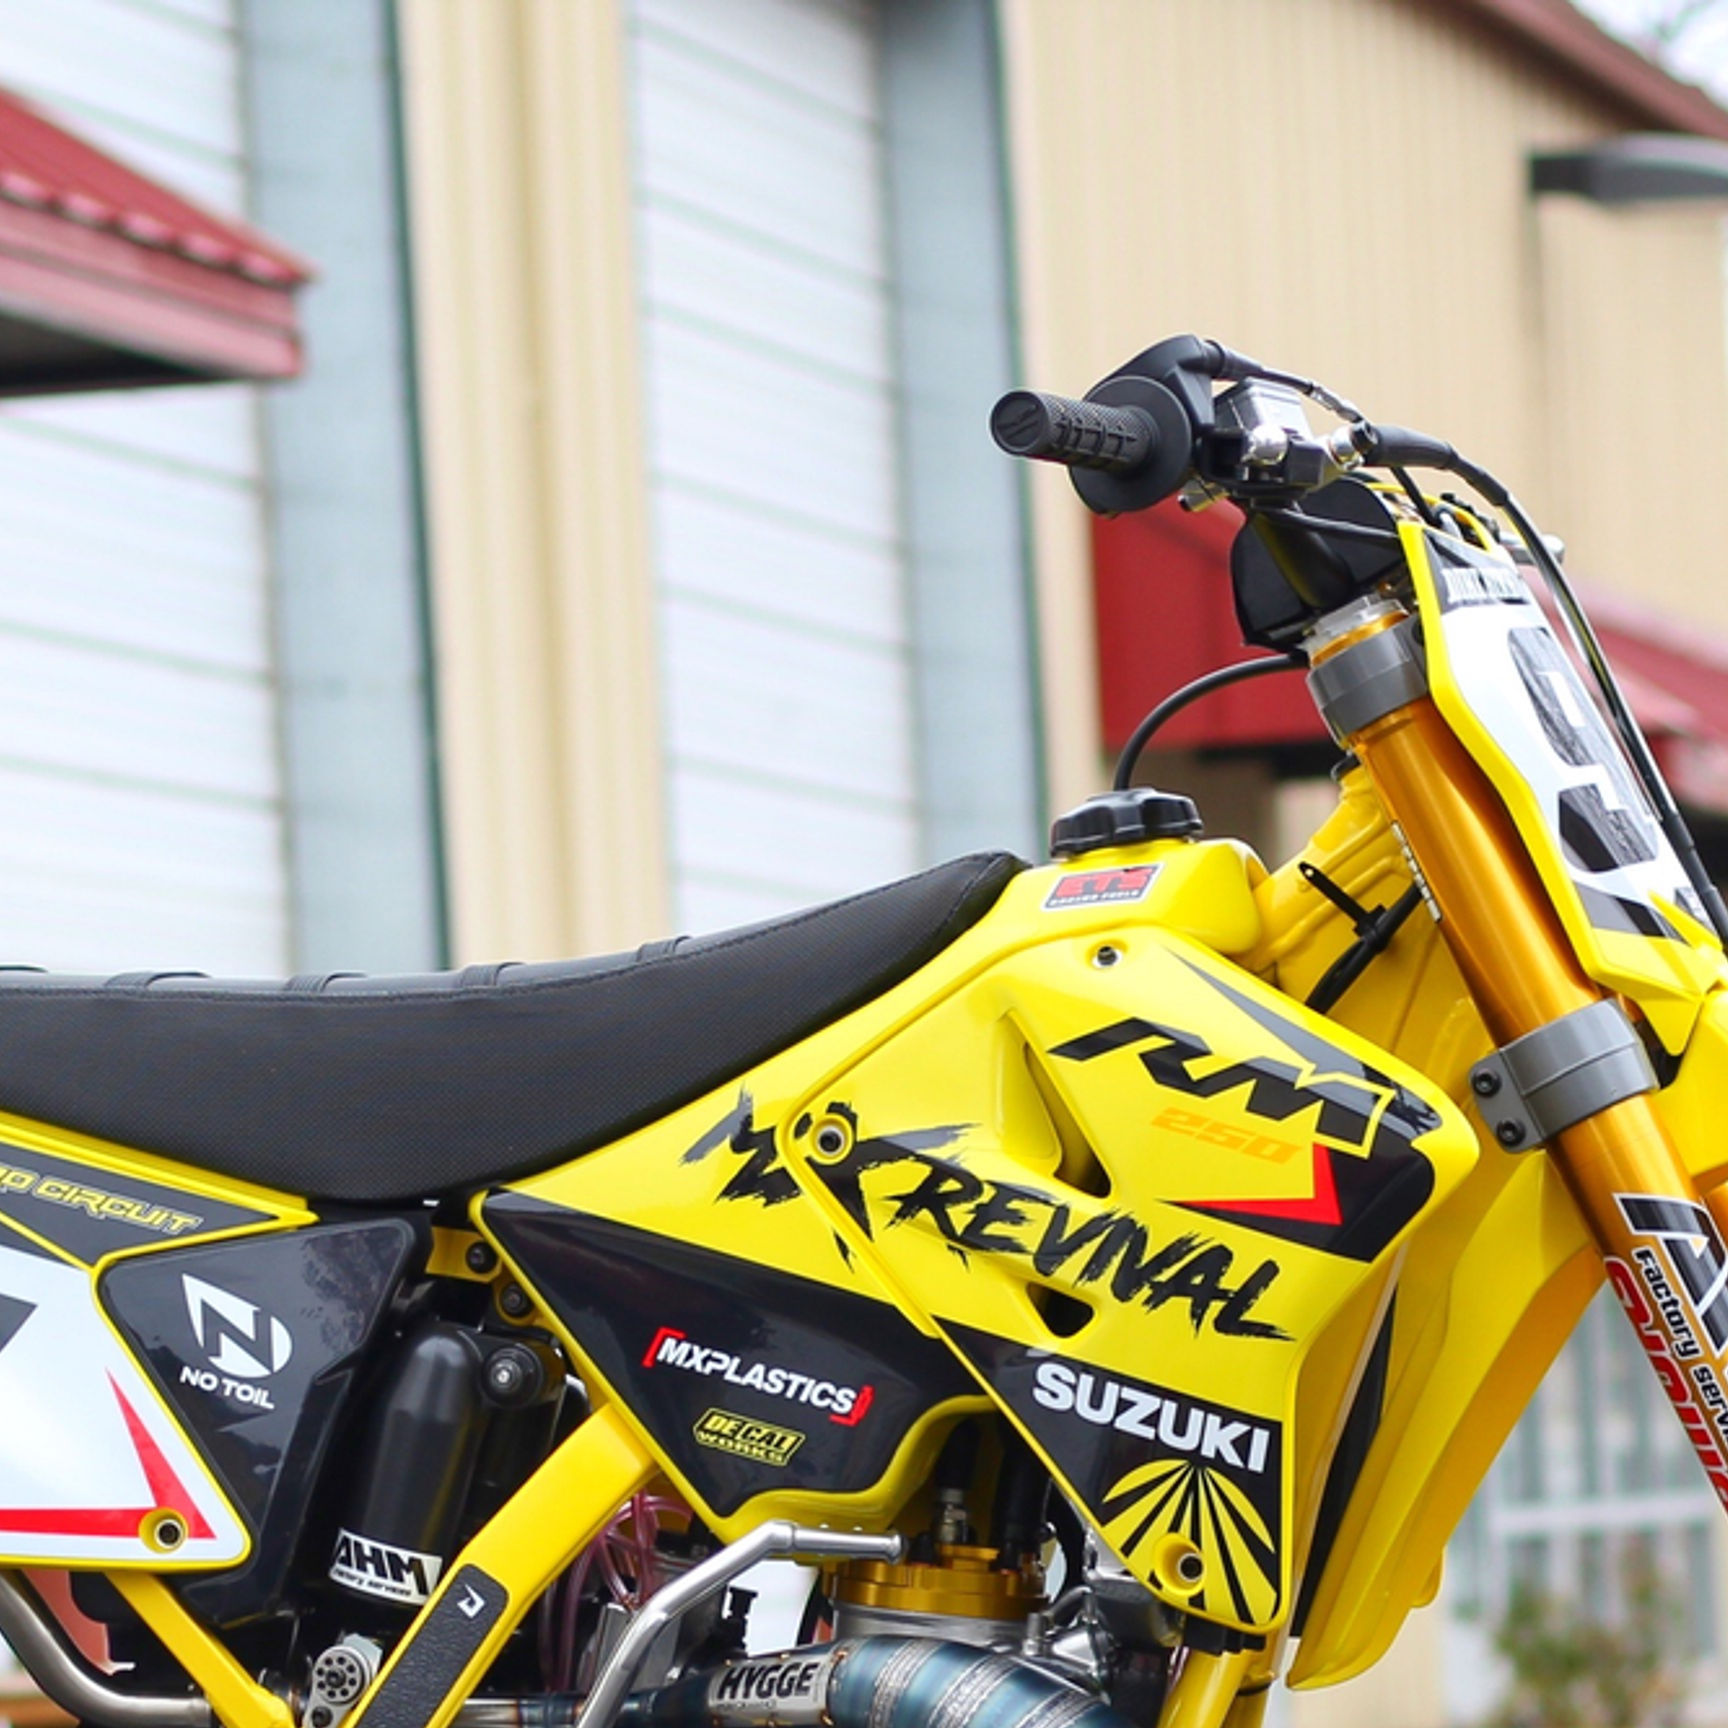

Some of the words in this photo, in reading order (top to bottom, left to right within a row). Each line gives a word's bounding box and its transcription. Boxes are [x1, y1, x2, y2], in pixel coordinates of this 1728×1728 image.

[1151, 1106, 1302, 1164] 250
[31, 1176, 204, 1235] CIRCUIT
[884, 1158, 1295, 1341] REVIVAL
[179, 1365, 217, 1392] NO
[222, 1378, 275, 1410] TOIL
[1032, 1362, 1270, 1474] SUZUKI
[716, 1661, 820, 1700] HYGGE
